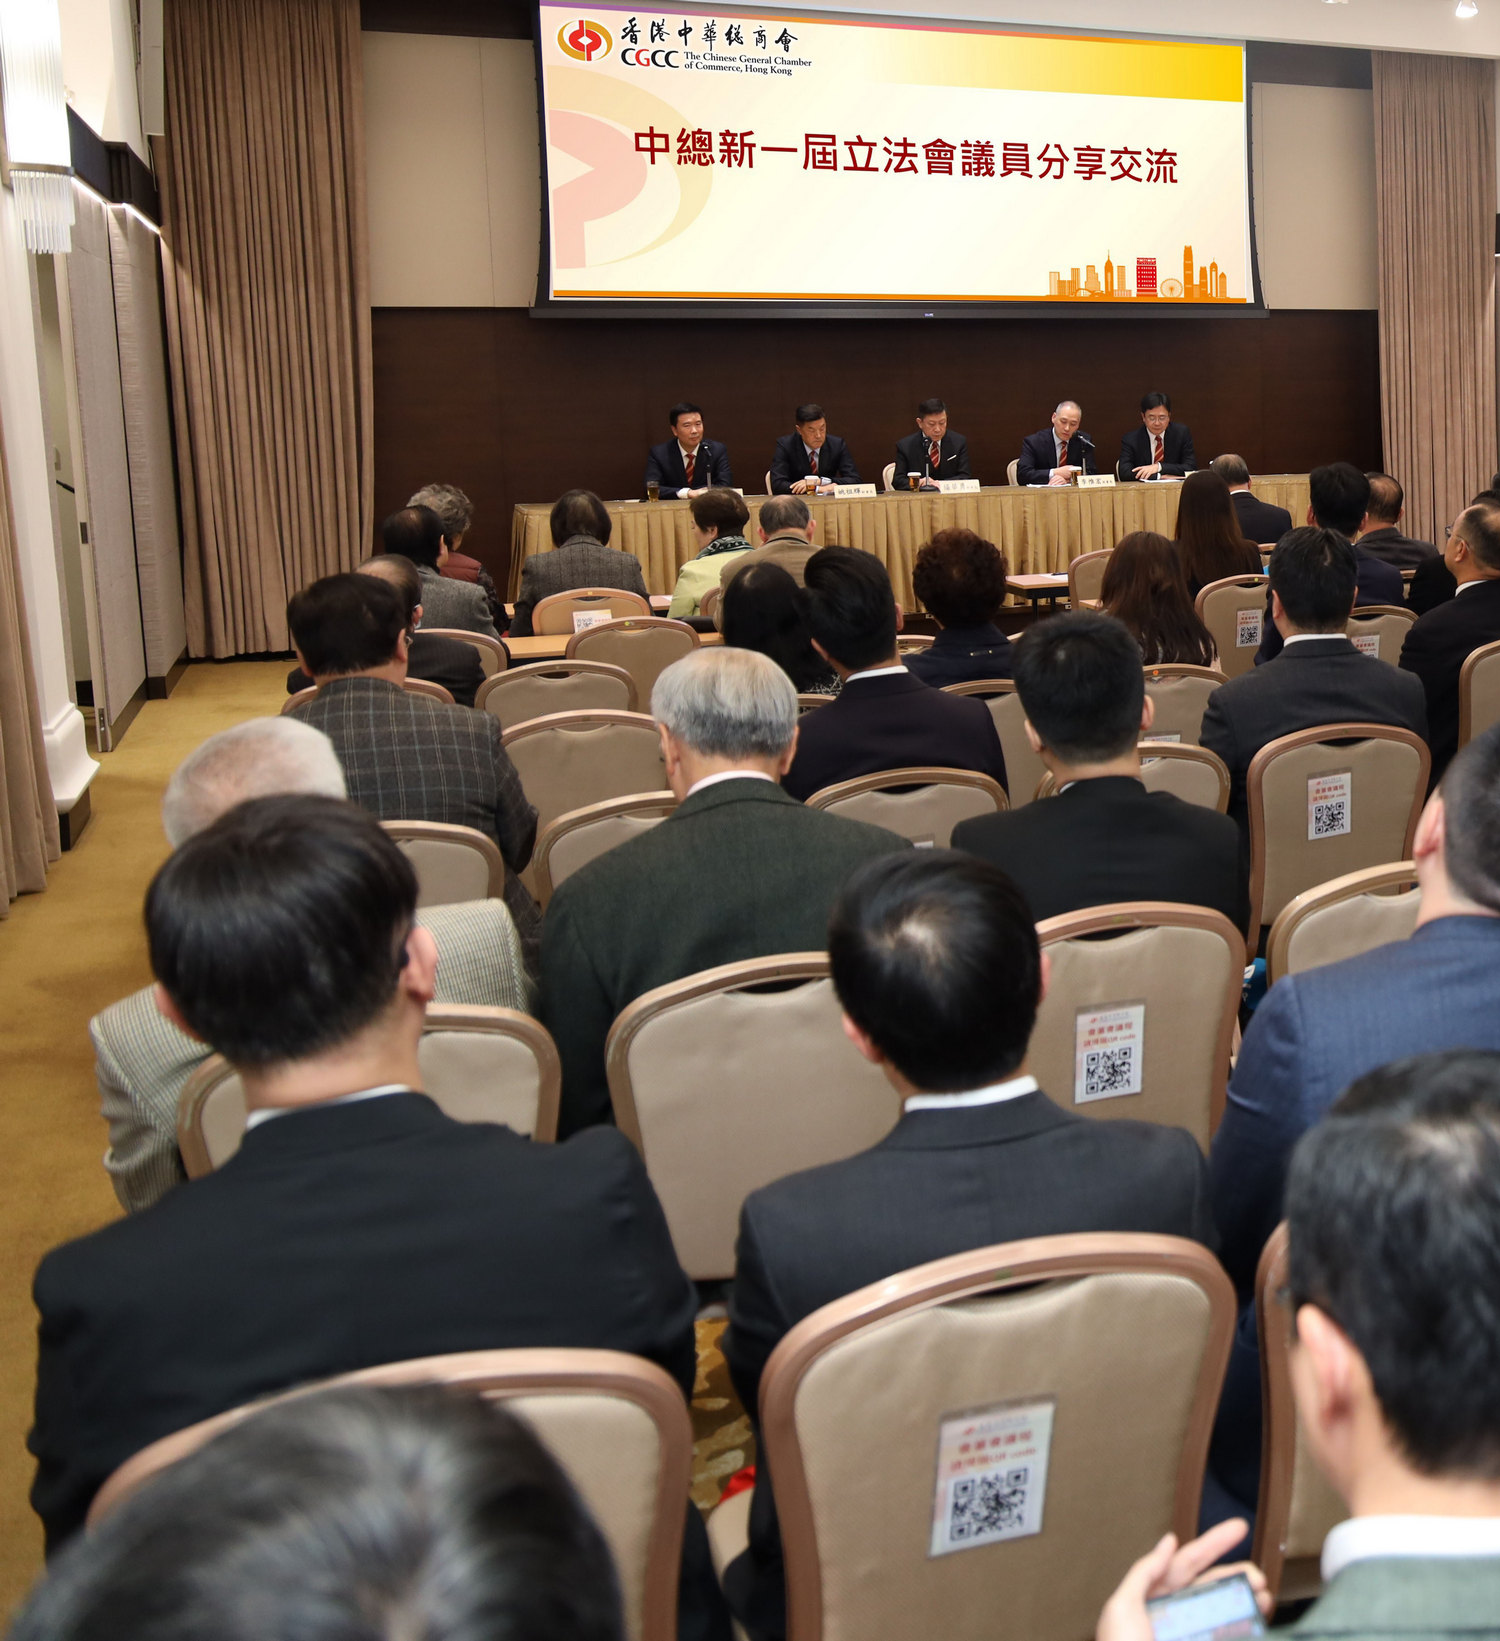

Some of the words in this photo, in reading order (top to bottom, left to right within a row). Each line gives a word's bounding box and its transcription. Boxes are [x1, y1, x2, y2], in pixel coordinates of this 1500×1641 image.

[620, 48, 680, 69] CGCC
[683, 52, 701, 61] The
[703, 53, 737, 63] Chinese
[739, 55, 772, 65] General
[774, 57, 812, 67] Chamber
[684, 61, 694, 70] of
[695, 62, 743, 73] Commerce,
[745, 65, 769, 75] Hong
[770, 66, 793, 76] Kong
[634, 126, 1179, 184] 中總新一屆立法會議員分享交流
